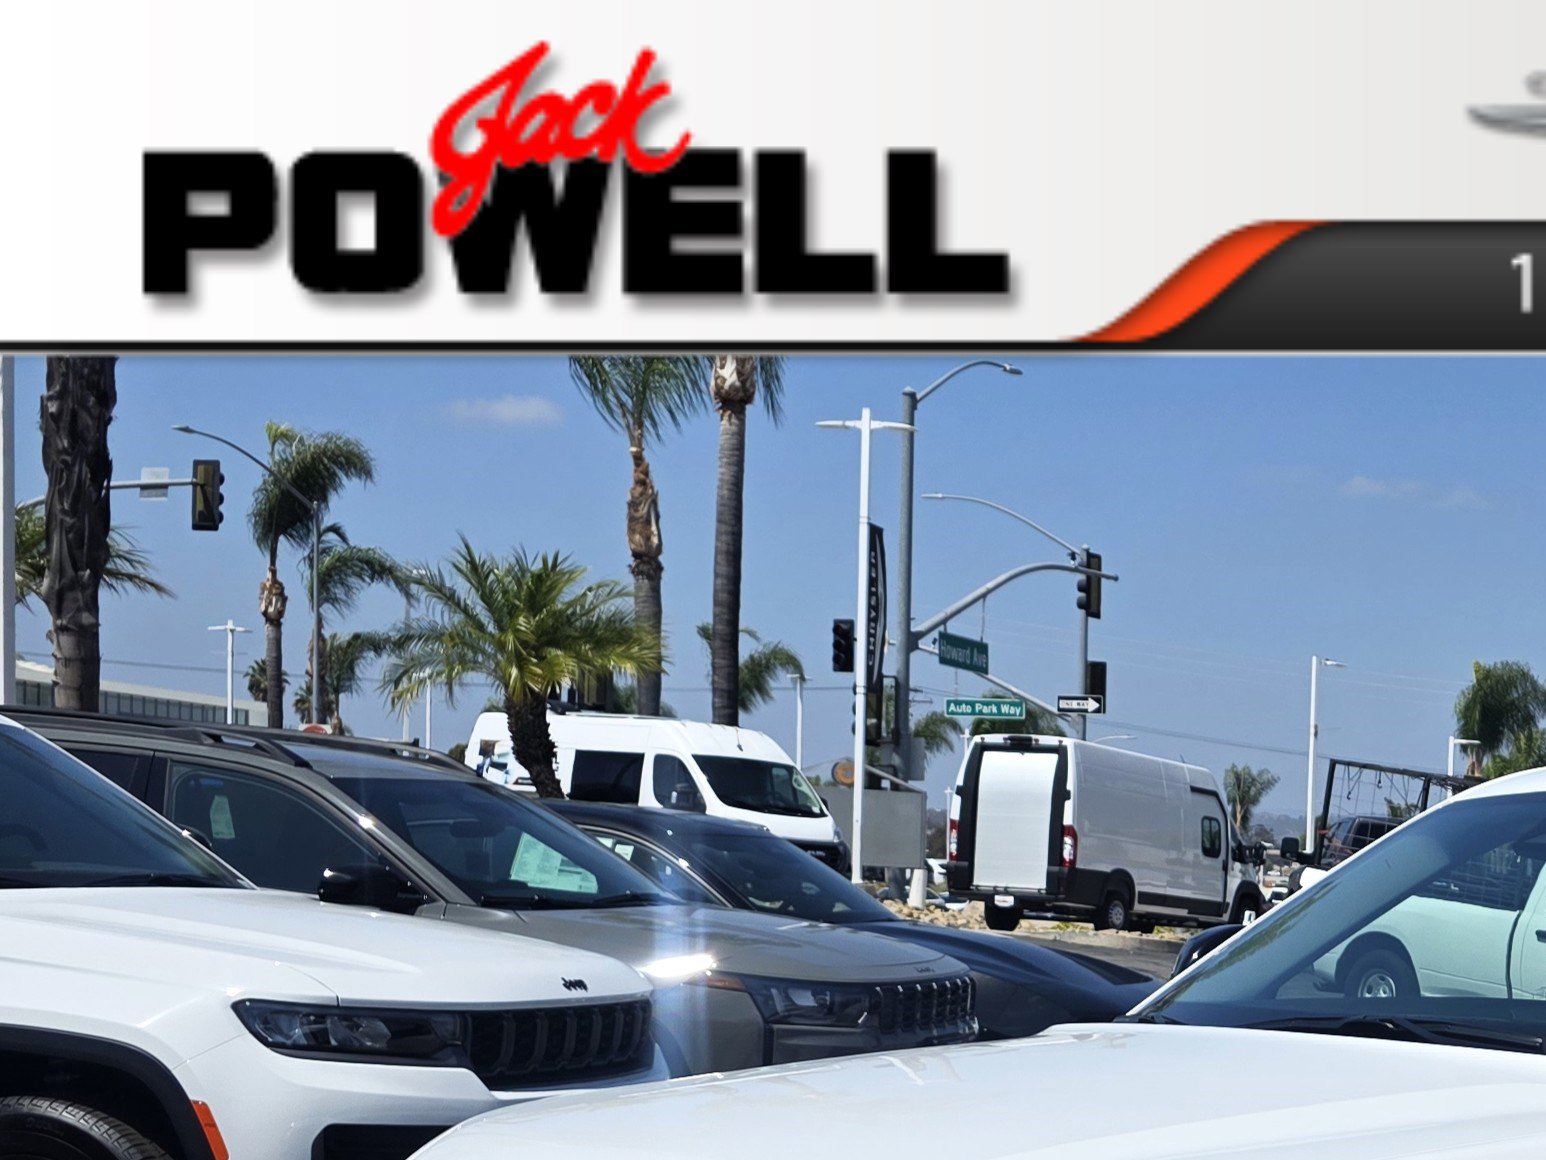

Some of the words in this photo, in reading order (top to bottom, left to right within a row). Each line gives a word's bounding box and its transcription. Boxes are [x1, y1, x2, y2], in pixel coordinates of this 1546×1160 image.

[869, 551, 877, 666] CHRYSLER
[940, 639, 971, 665] Howard
[972, 646, 987, 668] Ave
[948, 702, 972, 713] Auto
[975, 703, 998, 714] Park
[1000, 703, 1021, 716] Way
